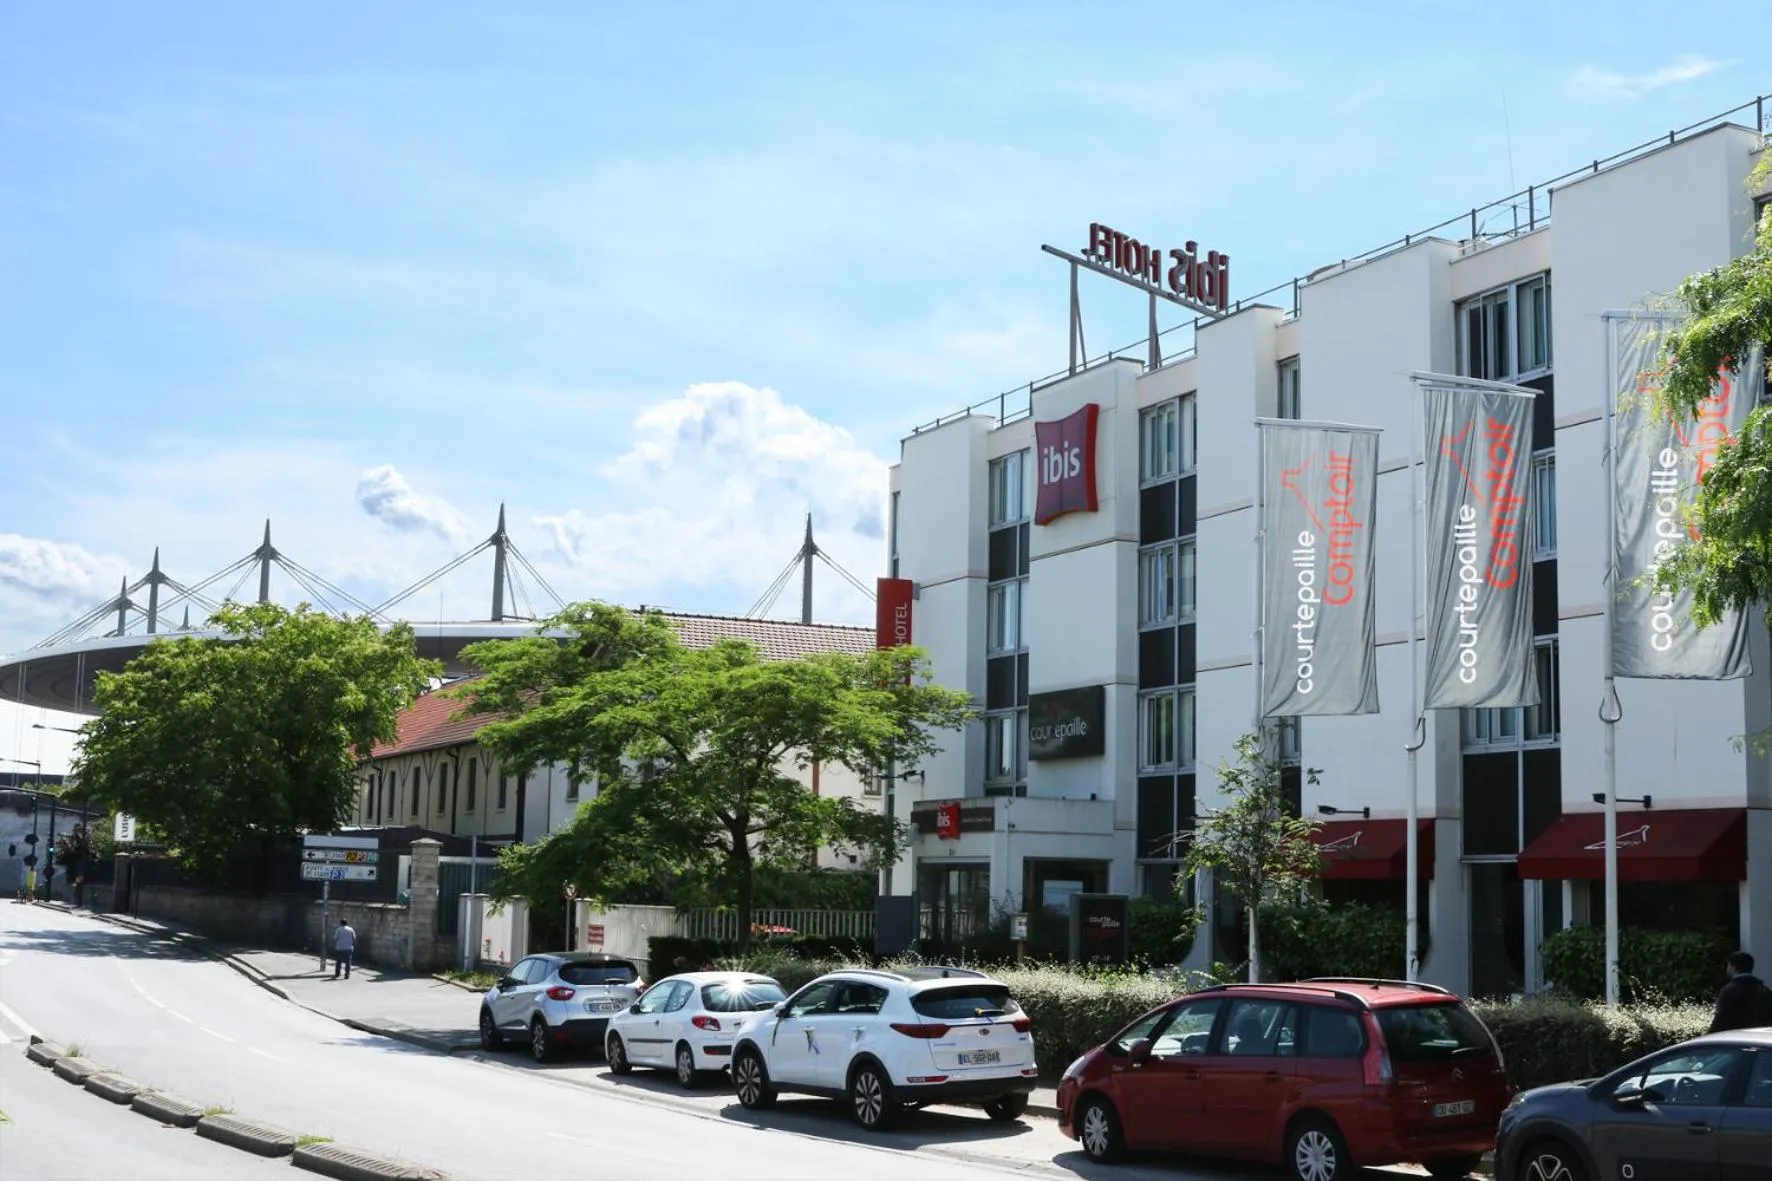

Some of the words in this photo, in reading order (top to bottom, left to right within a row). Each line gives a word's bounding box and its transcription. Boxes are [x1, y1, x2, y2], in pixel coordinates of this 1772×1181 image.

[1043, 440, 1081, 485] ibis
[895, 600, 908, 646] HOTEL
[1292, 529, 1321, 695] courtepaille
[1454, 503, 1484, 684] courtepaille
